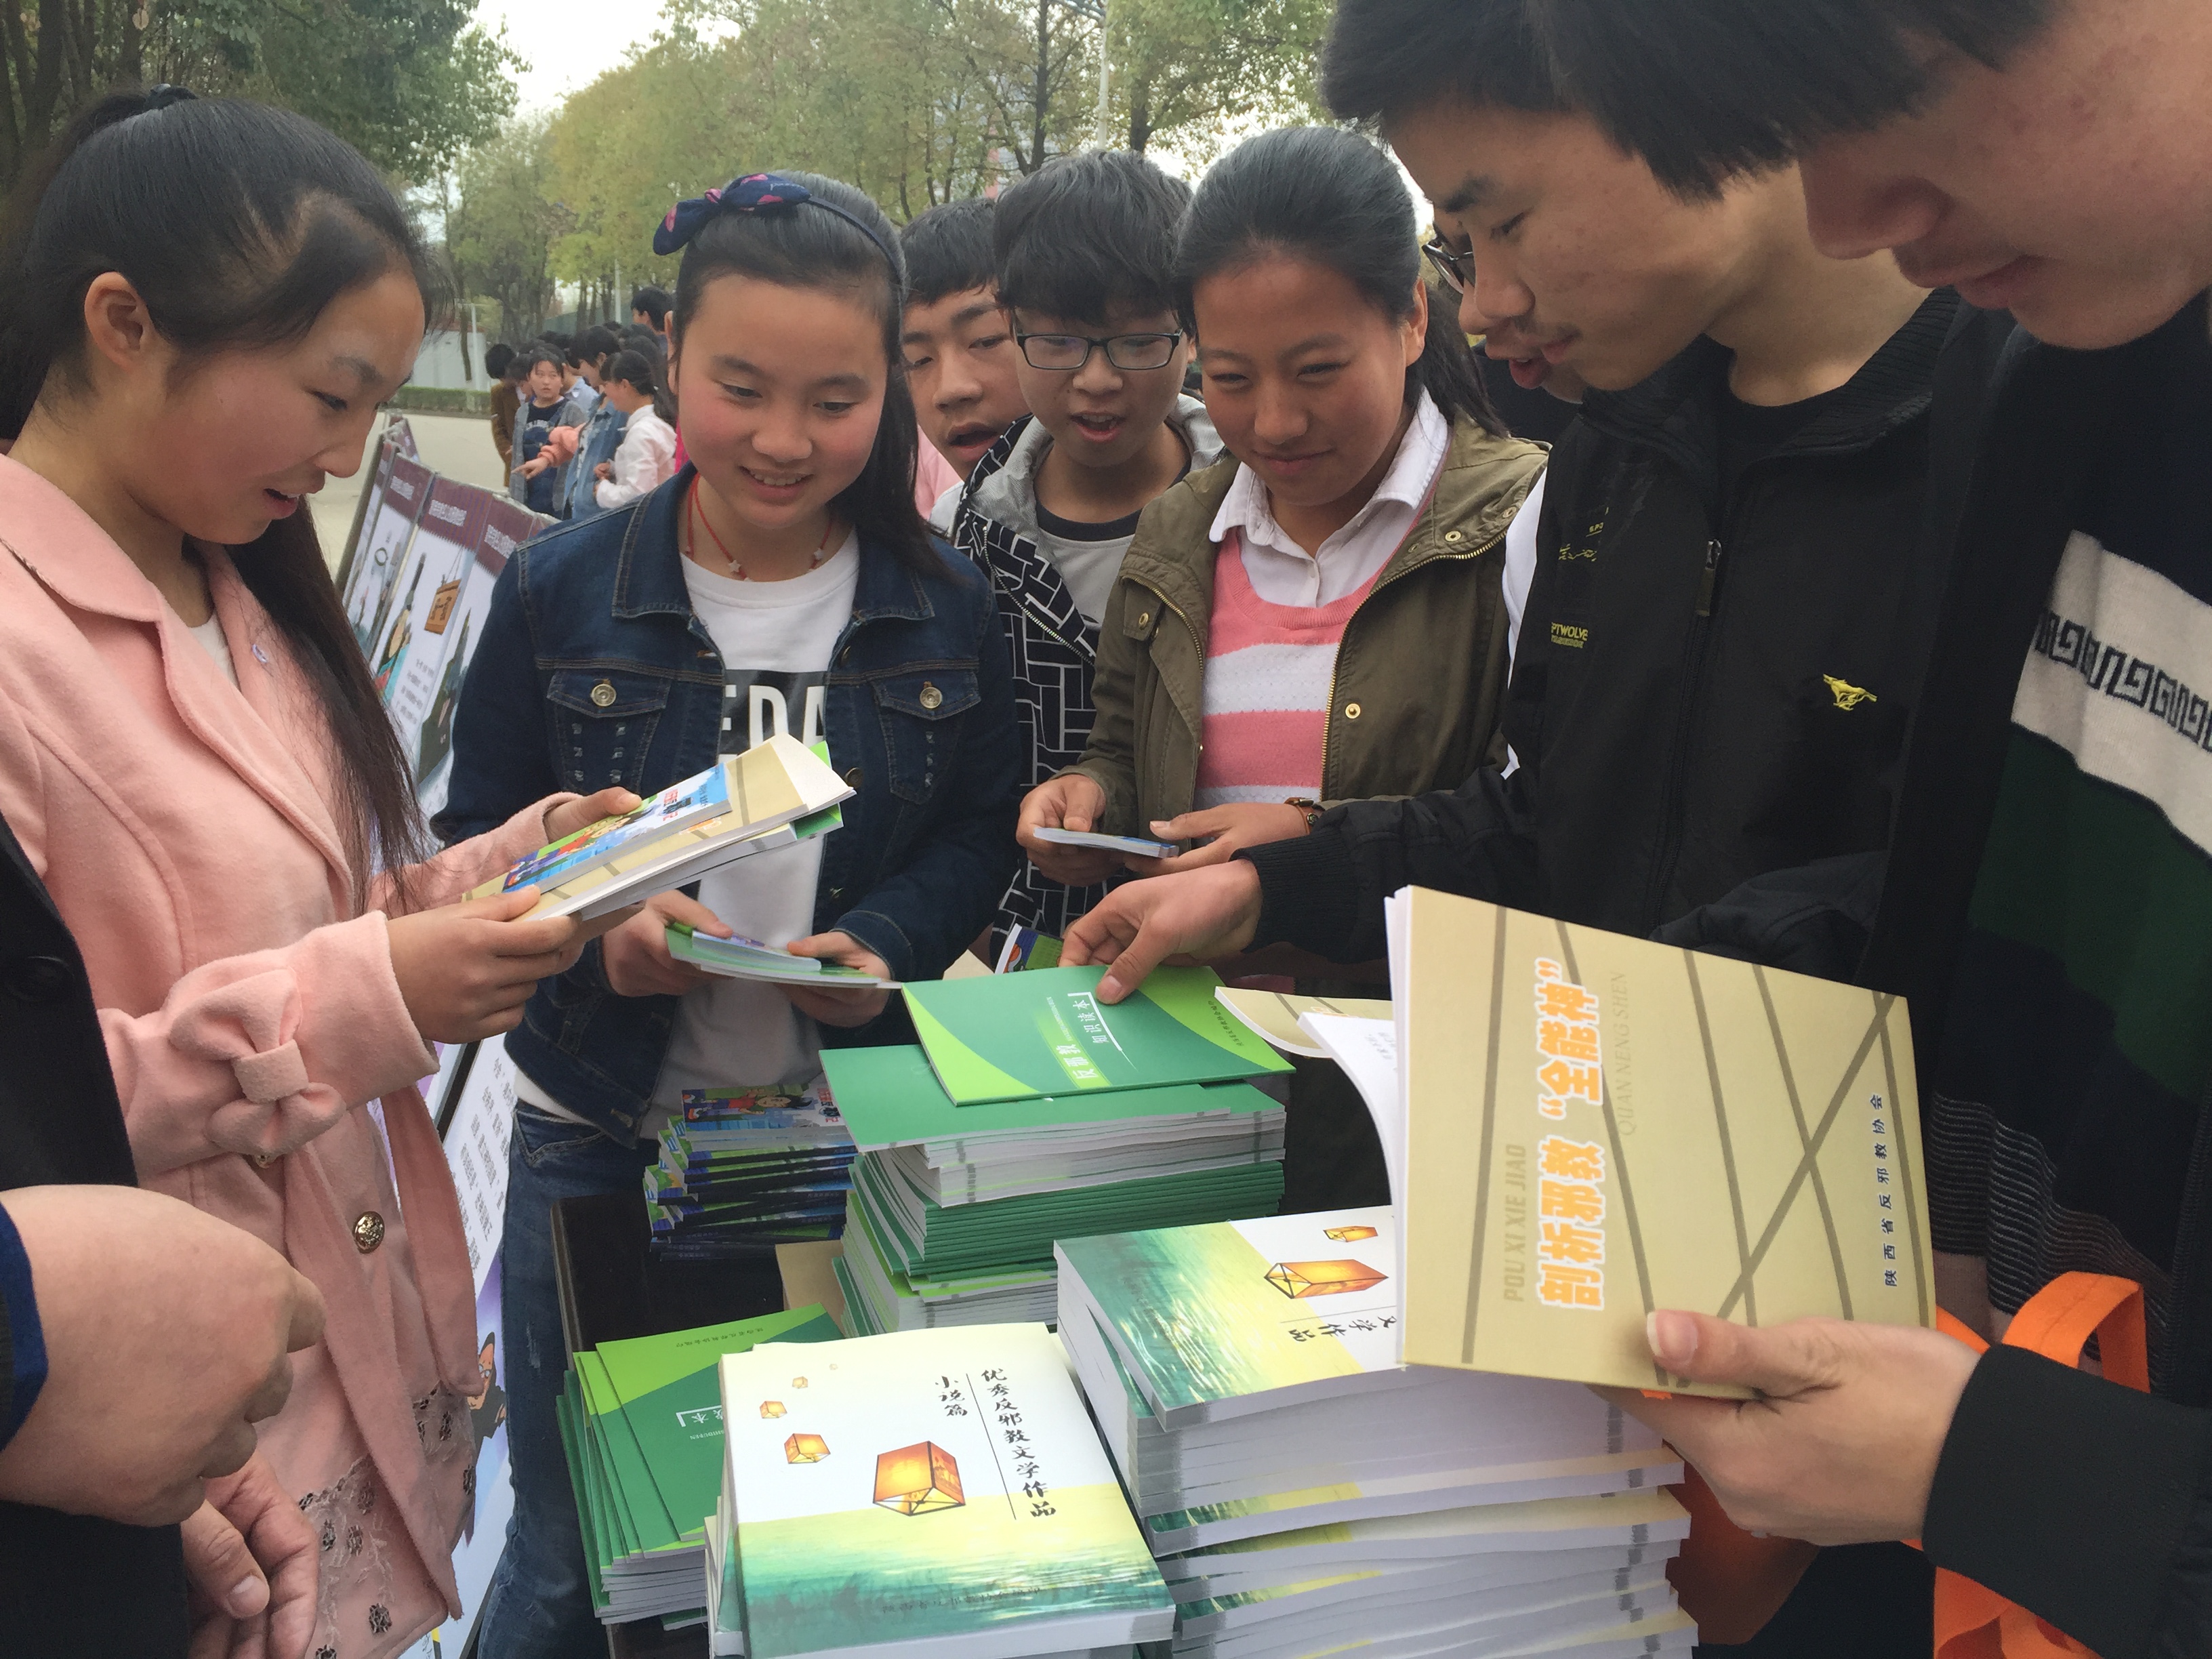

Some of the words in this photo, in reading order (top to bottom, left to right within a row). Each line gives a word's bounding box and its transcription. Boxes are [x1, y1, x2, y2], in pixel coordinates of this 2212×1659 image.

[1610, 972, 1629, 1019] SHEN
[1072, 1000, 1109, 1044] 知识读本
[1056, 1044, 1099, 1079] 反邪教
[1613, 1023, 1631, 1075] NENG
[1616, 1079, 1637, 1136] QUAN
[1504, 1144, 1525, 1191] JIAO
[1869, 1093, 1898, 1288] 陕西省反邪教协会
[1504, 1195, 1525, 1227] XIE
[1538, 1134, 1605, 1311] 剖析邪教
[1504, 1233, 1525, 1253] XI
[1504, 1259, 1525, 1302] POU
[935, 1375, 968, 1416] 小说篇
[981, 1368, 1057, 1518] 优秀反邪教文学作品
